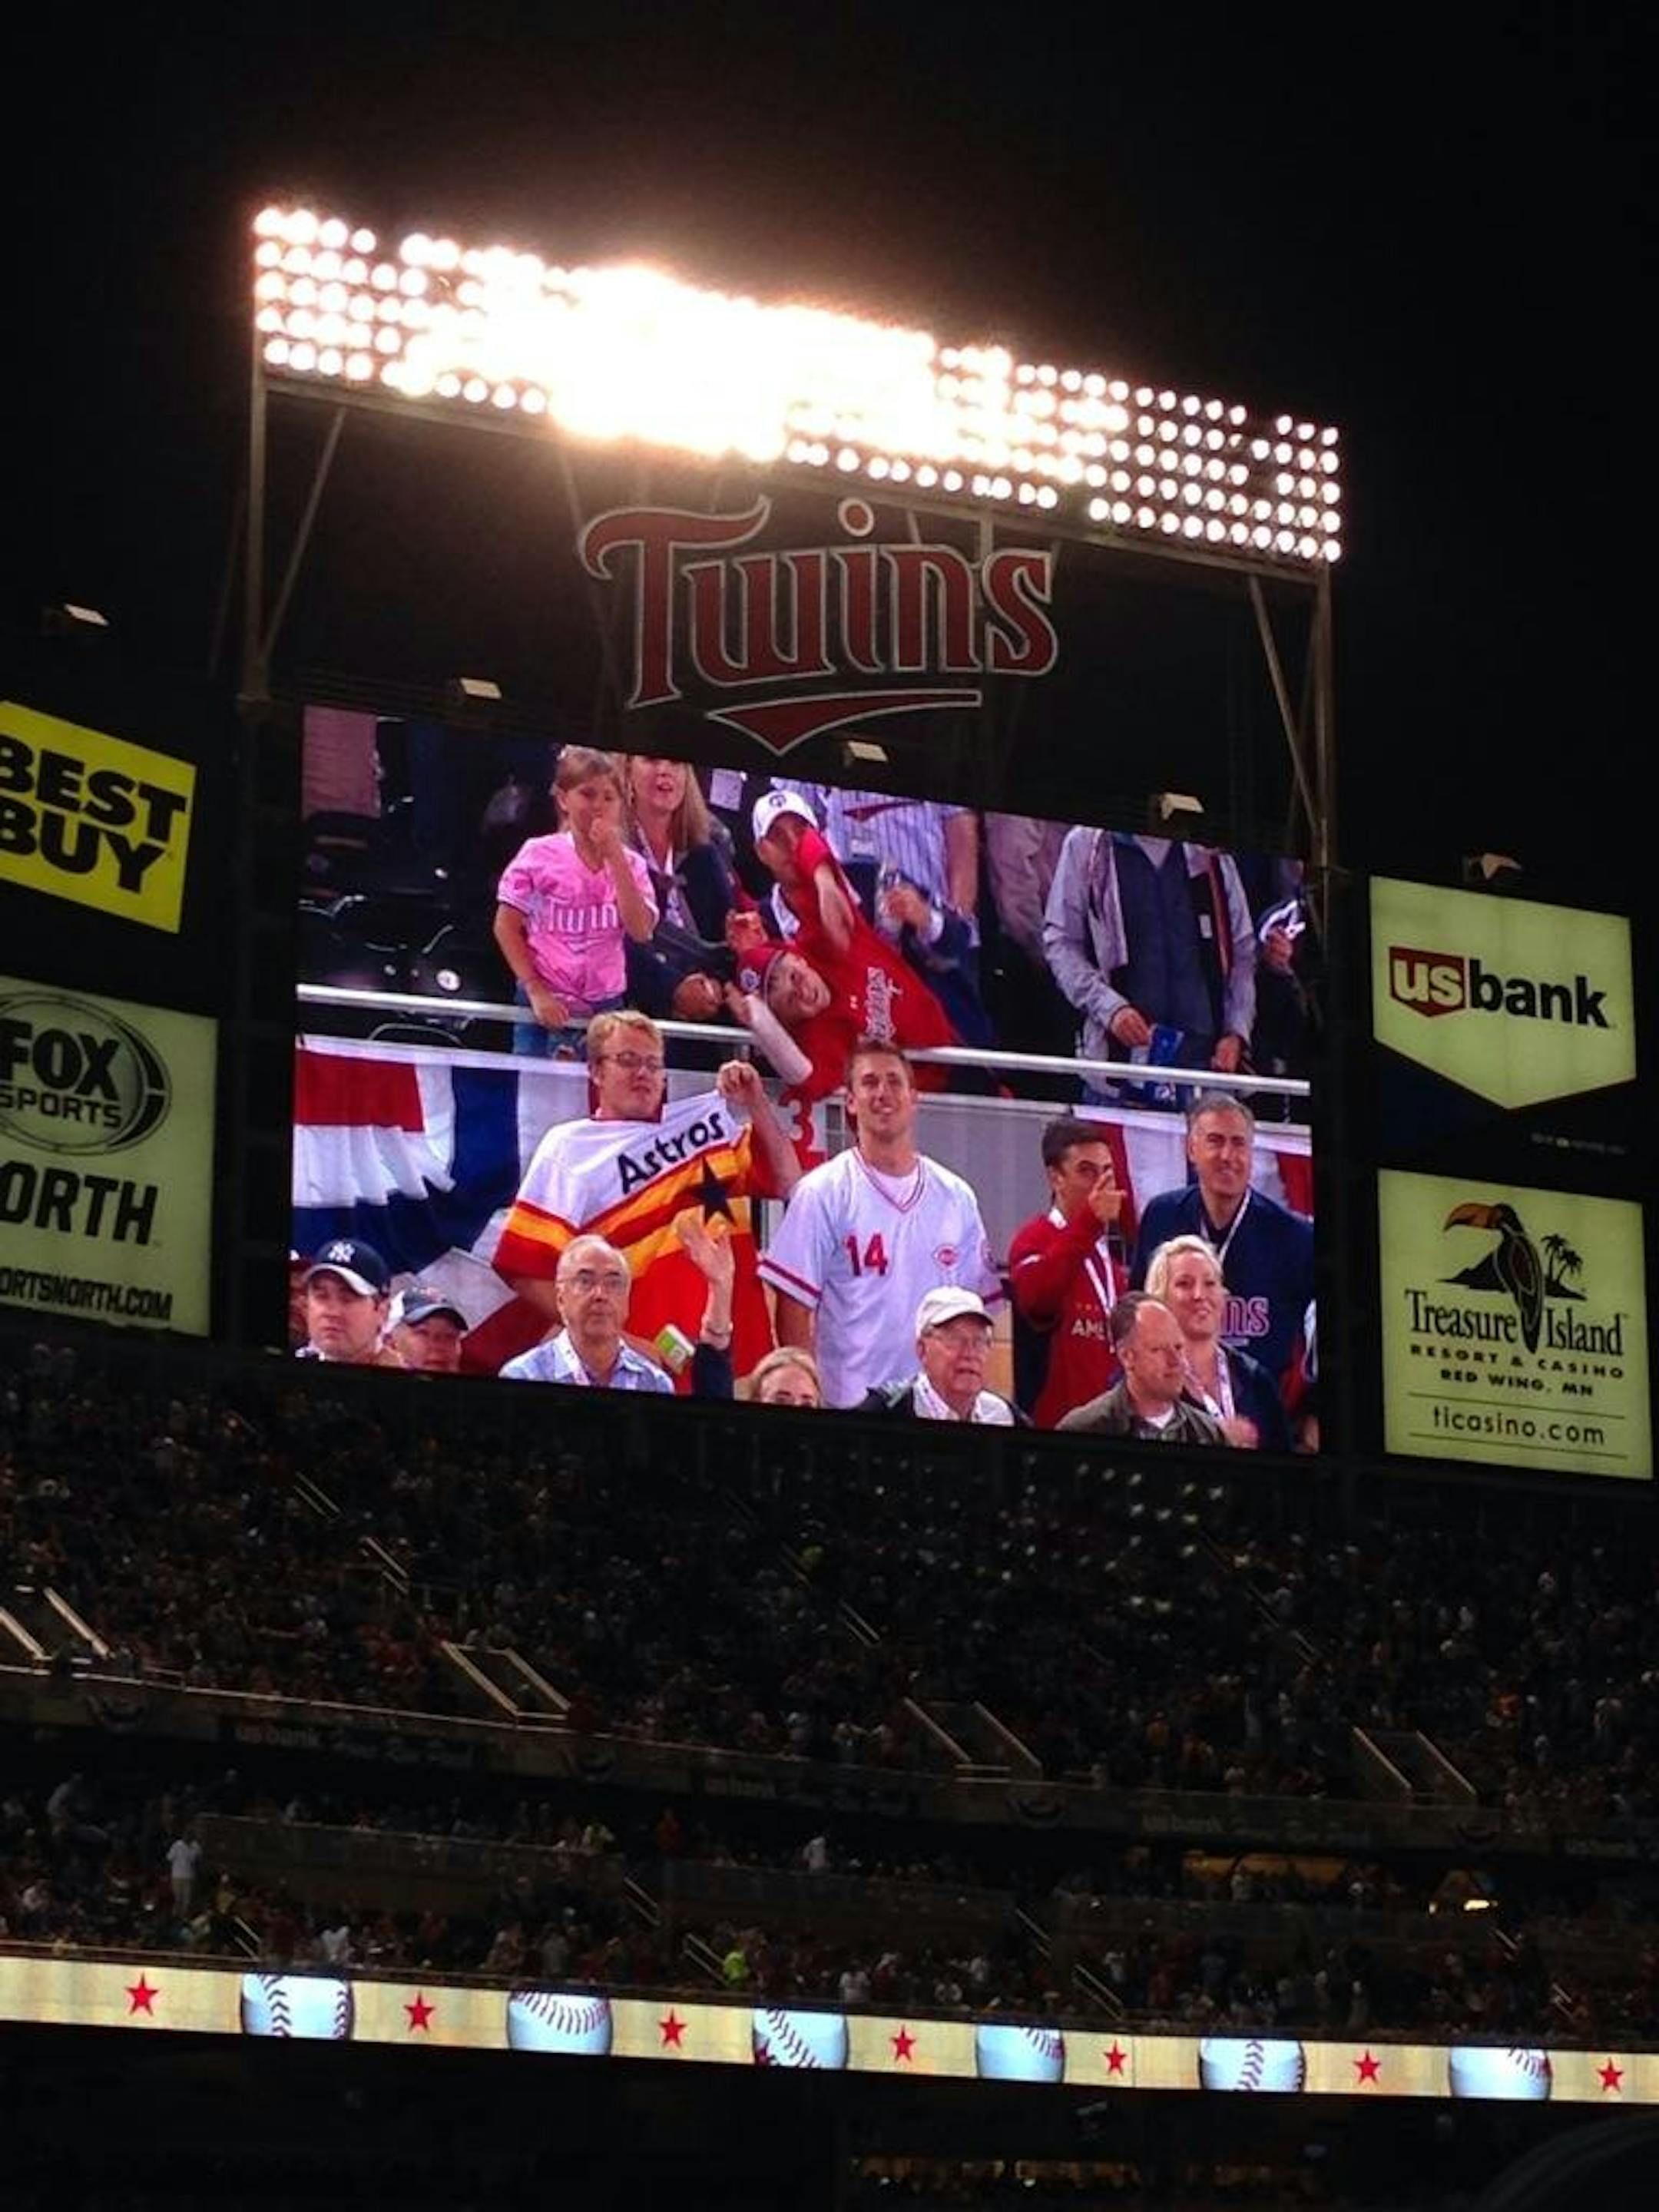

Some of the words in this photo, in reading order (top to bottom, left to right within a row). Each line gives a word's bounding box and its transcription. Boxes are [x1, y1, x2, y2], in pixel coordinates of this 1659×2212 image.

[579, 495, 1057, 708] Twins
[0, 733, 187, 843] BEST
[0, 796, 166, 894] BUY
[545, 895, 620, 932] Twin
[0, 1018, 120, 1101] FOX
[0, 1084, 121, 1128] SPORTS
[618, 1112, 725, 1194] Astros
[846, 1233, 888, 1277] 14
[1404, 1289, 1517, 1343] Treasure
[1546, 1308, 1624, 1356] Island
[1410, 1344, 1498, 1364] RESORT
[1511, 1356, 1524, 1367] &
[1538, 1359, 1624, 1379] CASINO
[1441, 1369, 1479, 1382] RED
[1561, 1382, 1593, 1396] MN
[1434, 1406, 1605, 1445] ticasino.com
